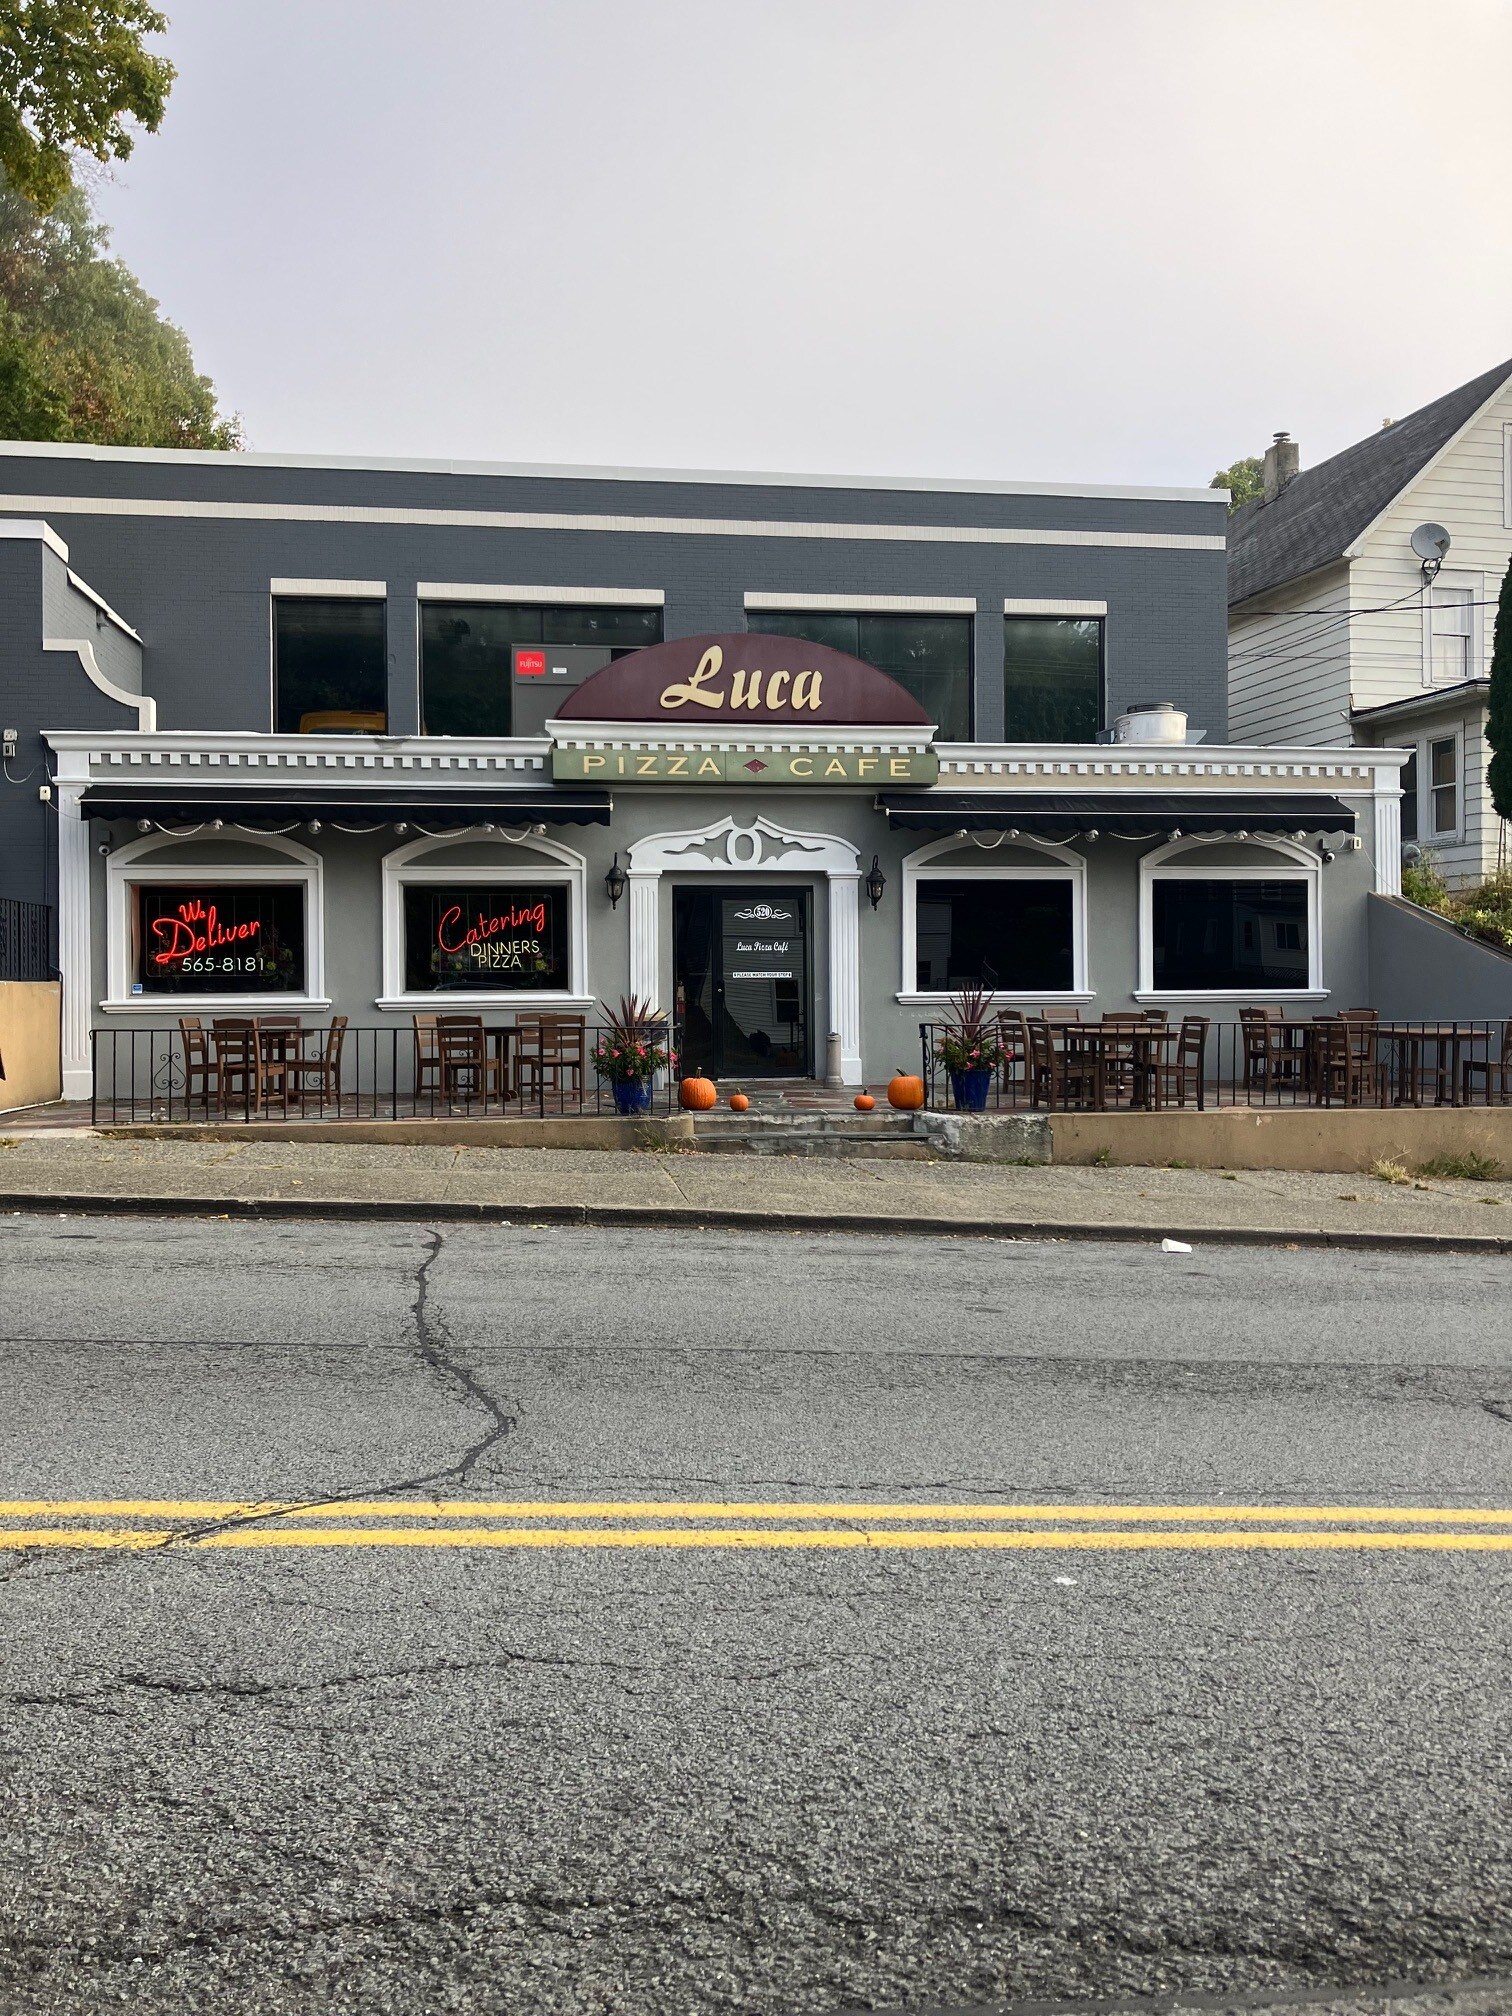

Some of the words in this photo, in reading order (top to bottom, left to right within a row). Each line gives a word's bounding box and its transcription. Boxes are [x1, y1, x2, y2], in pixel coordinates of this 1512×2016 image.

[520, 659, 542, 668] FUJITSU
[659, 645, 823, 710] Luca
[582, 755, 722, 776] PIZZA
[789, 757, 911, 778] CAFE
[178, 899, 206, 922] We
[756, 907, 770, 916] 520
[152, 905, 260, 963] Deliver
[438, 903, 545, 952] Catering
[470, 940, 540, 957] DINNERS
[736, 941, 752, 951] Luca
[753, 941, 772, 951] Pizza
[773, 941, 789, 953] Café
[181, 957, 264, 972] 565-8181
[478, 954, 522, 969] PIZZA
